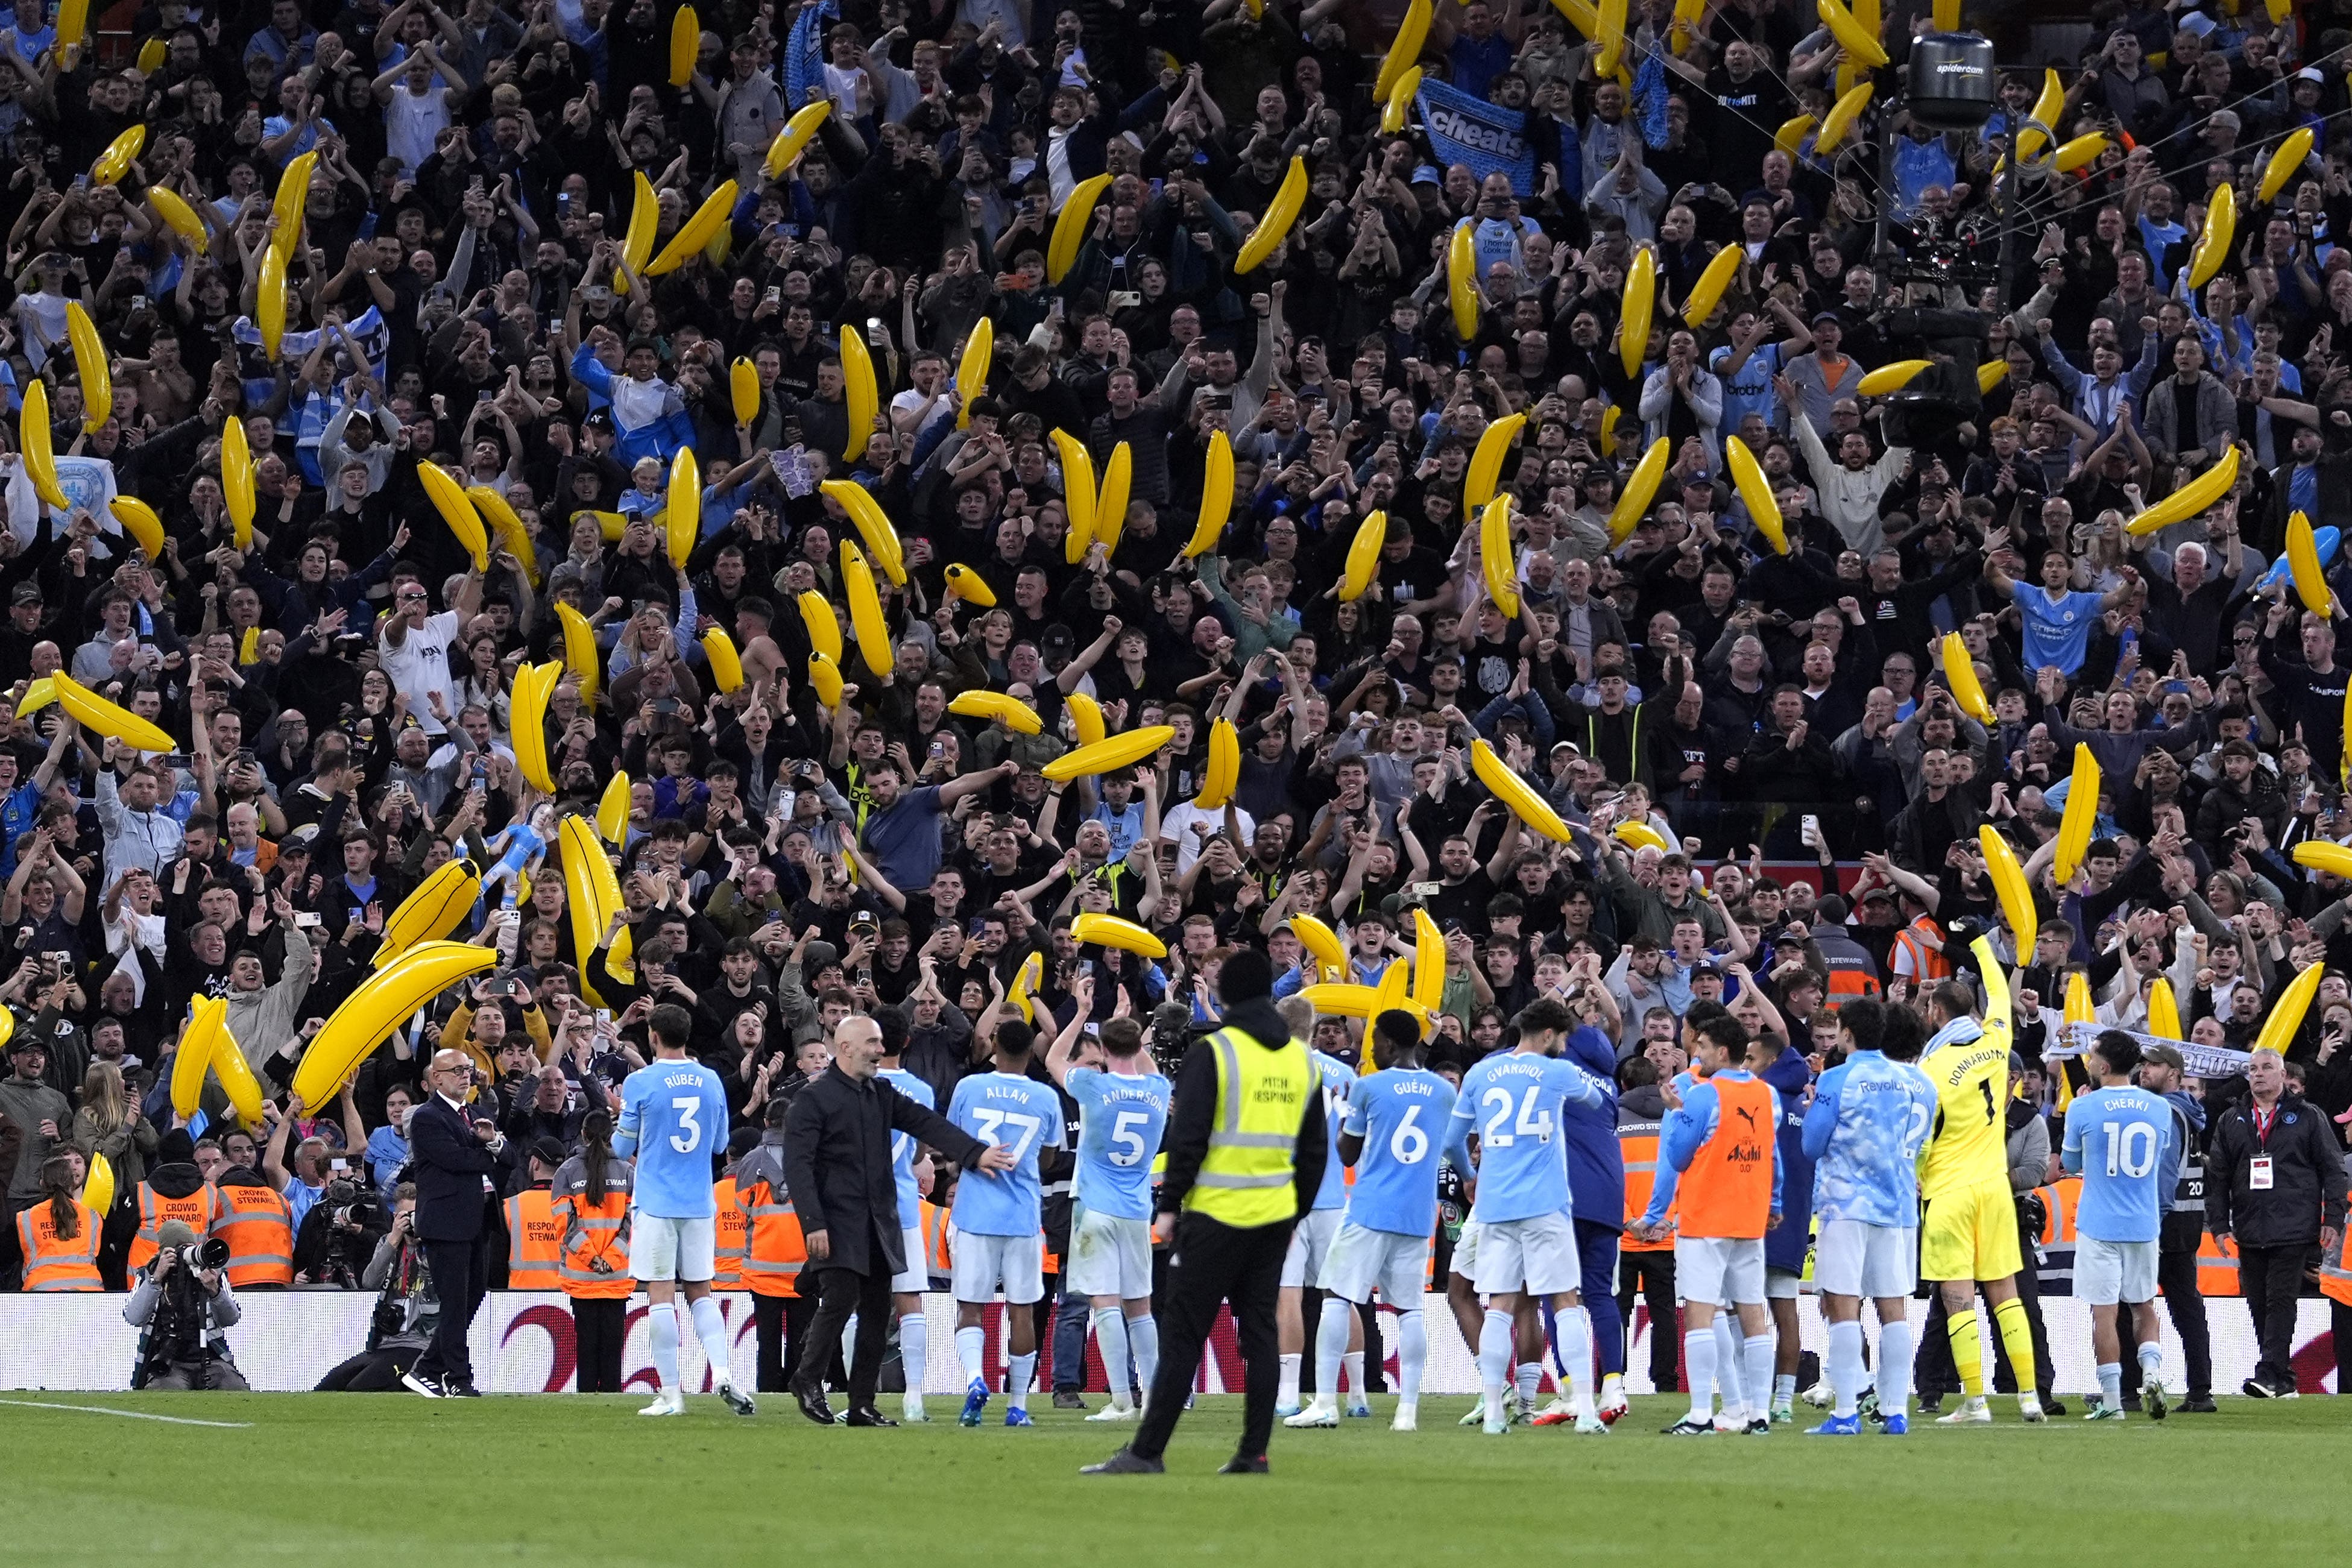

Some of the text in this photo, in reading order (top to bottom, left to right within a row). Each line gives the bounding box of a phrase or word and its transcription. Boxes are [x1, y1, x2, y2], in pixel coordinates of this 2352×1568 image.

[1937, 64, 1984, 75] spidercam
[1429, 110, 1523, 159] cheats
[1486, 1063, 1545, 1083] GVARDIOL
[986, 1087, 1029, 1105] ALLAN
[1393, 1078, 1433, 1097] GUÉHI
[1859, 1080, 1903, 1094] Revolu
[1102, 1089, 1162, 1112] ANDERSON
[1978, 1077, 1995, 1126] 1
[2104, 1098, 2149, 1112] CHERKI
[669, 1096, 701, 1153] 3
[1482, 1086, 1554, 1147] 24
[1390, 1105, 1428, 1164] 6
[1617, 1124, 1645, 1133] CROWD
[972, 1107, 1041, 1171] 37
[1108, 1111, 1149, 1167] 5
[1727, 1144, 1761, 1162] Asahi
[2103, 1122, 2157, 1178] 10
[571, 1180, 587, 1189] CRO
[2187, 1181, 2204, 1196] 20
[166, 1203, 197, 1212] CROWD
[161, 1214, 201, 1223] STEWARD
[528, 1222, 556, 1231] RESPON
[724, 1222, 745, 1231] STEW
[529, 1233, 558, 1242] STEWA
